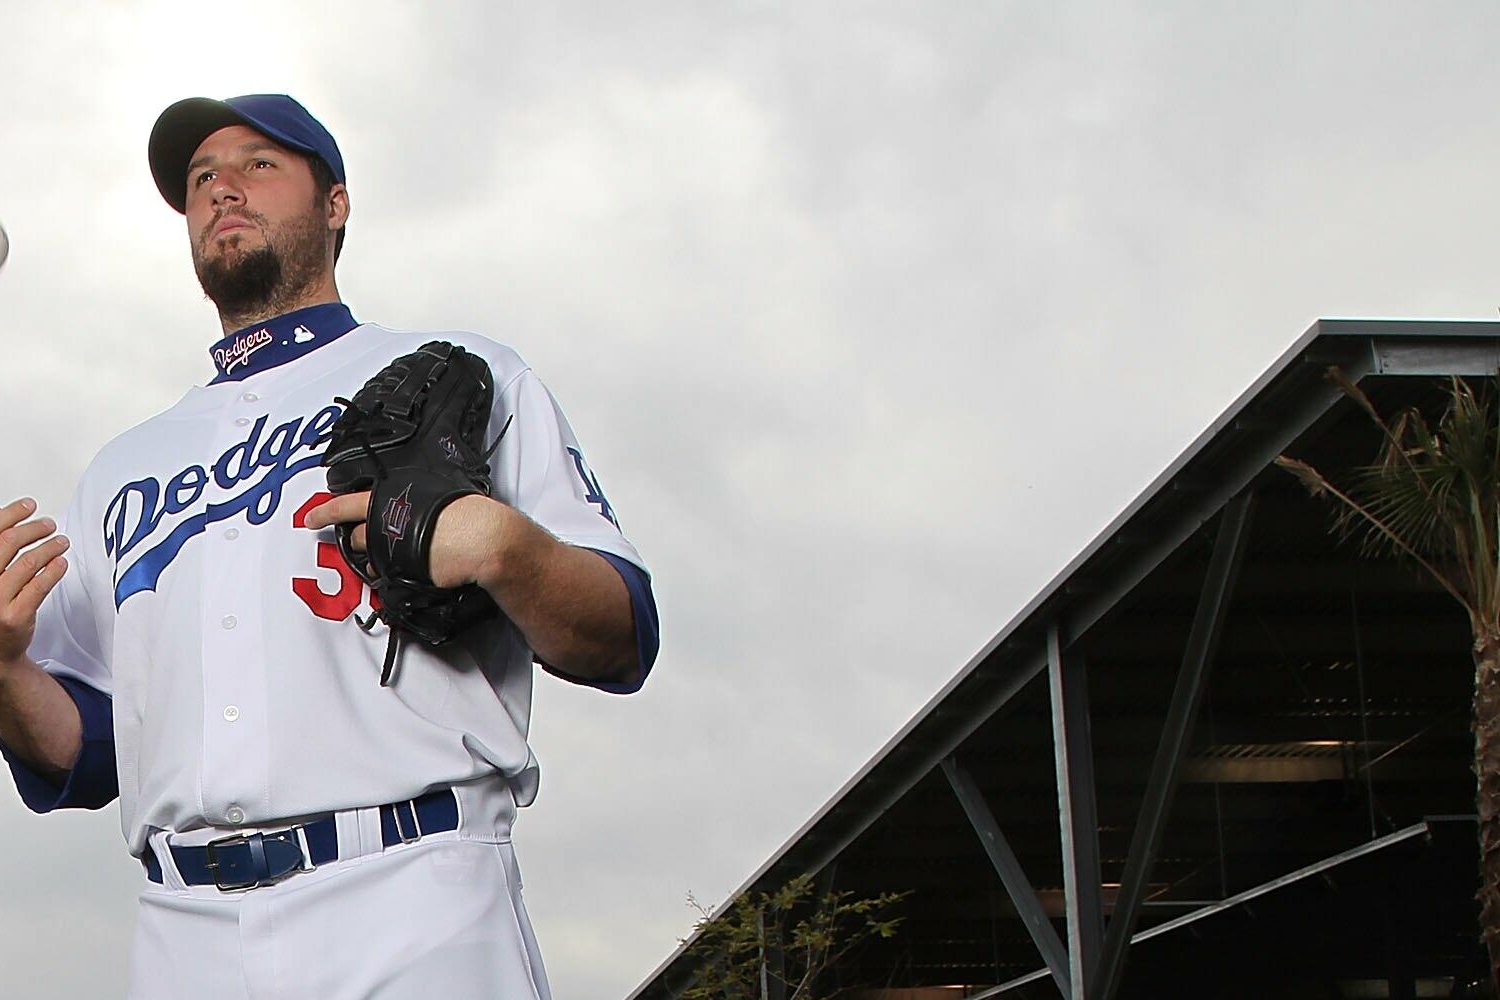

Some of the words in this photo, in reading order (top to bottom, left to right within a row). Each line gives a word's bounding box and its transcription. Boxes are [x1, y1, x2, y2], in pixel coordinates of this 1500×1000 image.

[214, 328, 273, 375] Dodgers
[103, 405, 343, 600] Dodge
[292, 492, 381, 622] 3
